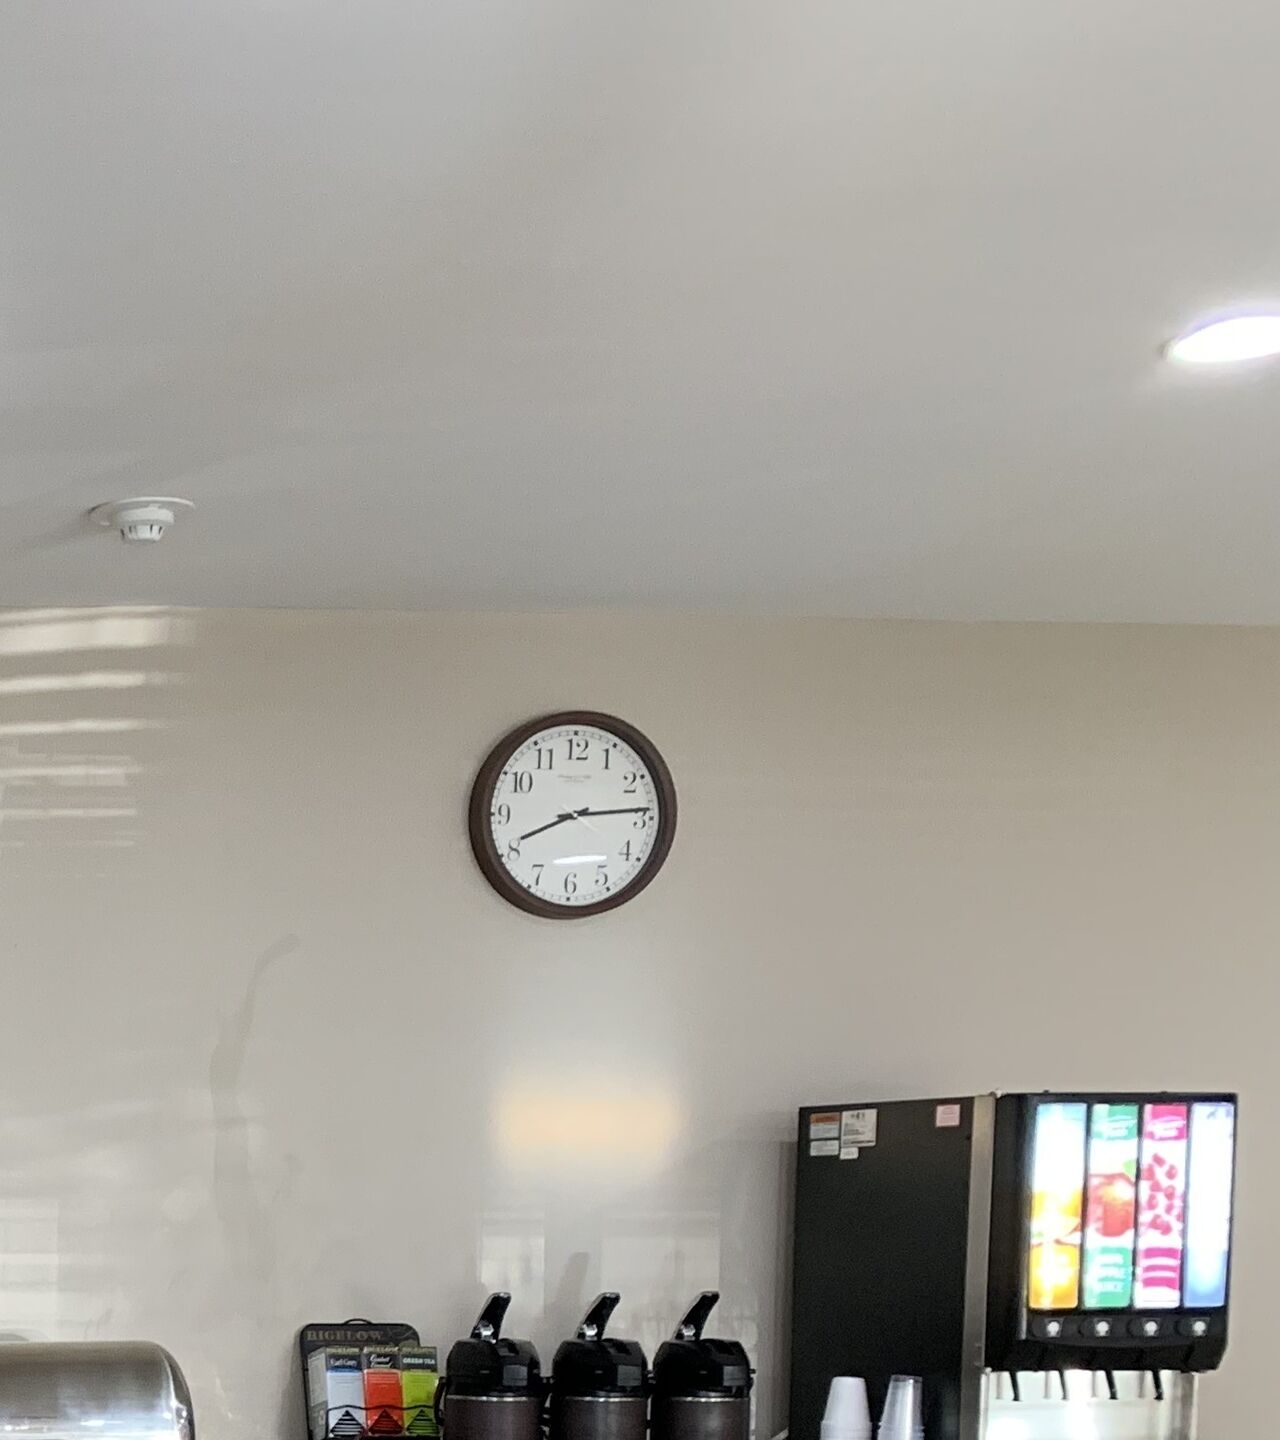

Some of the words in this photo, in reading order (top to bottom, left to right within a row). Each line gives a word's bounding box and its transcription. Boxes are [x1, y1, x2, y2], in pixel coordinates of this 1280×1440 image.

[535, 748, 553, 770] 11
[566, 738, 589, 760] 12
[602, 748, 610, 770] 1
[511, 771, 533, 794] 10
[623, 771, 637, 793] 2
[498, 804, 511, 825] 9
[633, 808, 647, 829] 3
[507, 839, 521, 861] 8
[619, 840, 632, 861] 4
[532, 864, 544, 886] 7
[564, 872, 577, 894] 6
[595, 865, 608, 886] 5
[306, 1330, 382, 1341] BIGELOW
